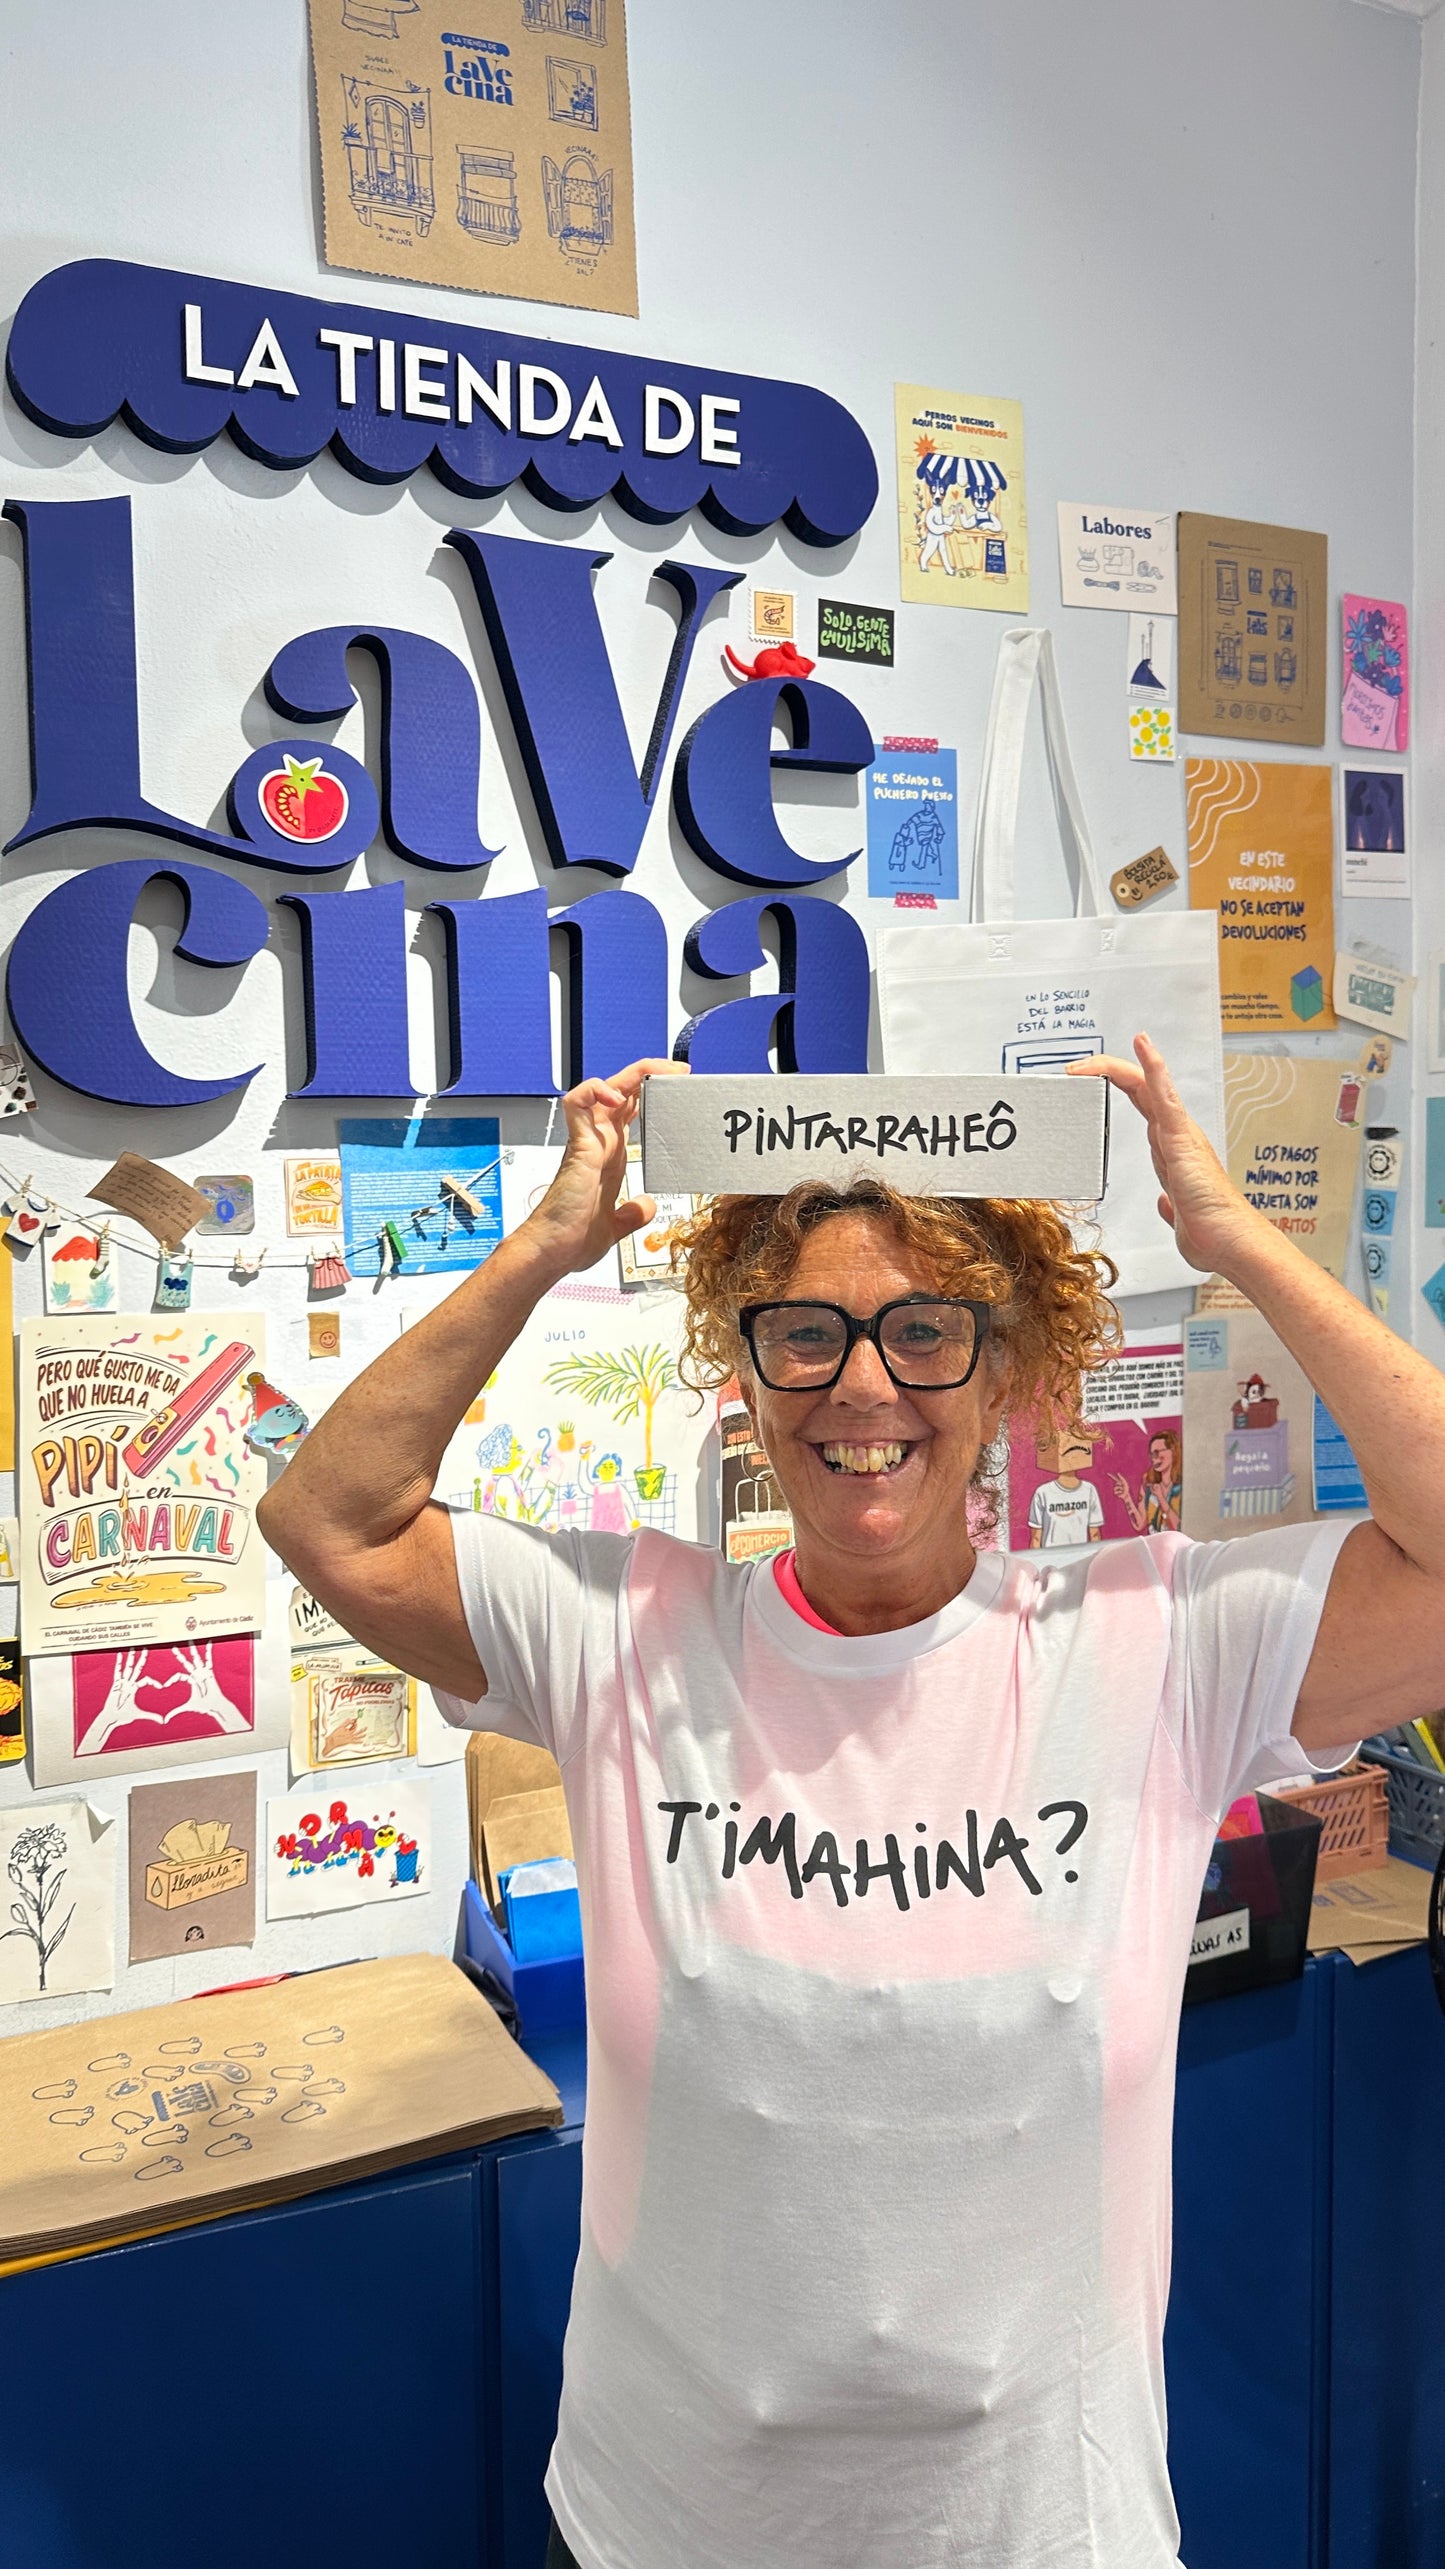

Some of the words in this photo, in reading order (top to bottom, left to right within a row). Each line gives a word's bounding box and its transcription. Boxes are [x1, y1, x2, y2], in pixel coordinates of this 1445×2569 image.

[184, 305, 299, 396] LA
[320, 328, 623, 448] TIENDA
[645, 384, 742, 467] DE
[925, 410, 957, 423] PERROS
[960, 415, 995, 428] VECINOS
[912, 417, 933, 429] AQUÍ
[935, 421, 953, 431] SON
[955, 424, 1008, 440] BIENVENIDOS
[1082, 515, 1152, 539] Labores
[823, 608, 852, 631] SOLO
[856, 615, 890, 638] GENTE
[872, 773, 888, 784] HE
[892, 773, 929, 787] DEJADO
[931, 776, 944, 787] EL
[874, 787, 919, 800] PUCHERO
[921, 790, 953, 801] PUESTO
[1123, 856, 1156, 880] BOLSITA
[1240, 850, 1256, 868] EN
[1257, 850, 1286, 869] ESTE
[1228, 875, 1295, 893] VECINDARIO
[1220, 899, 1237, 916] NO
[1240, 899, 1254, 917] SE
[1256, 901, 1305, 917] ACEPTAN
[1221, 924, 1307, 942] DEVOLUCIONES
[1025, 993, 1037, 1002] EN
[1039, 992, 1049, 1002] LO
[1053, 989, 1090, 1001] SENCILLO
[1029, 1007, 1048, 1017] DEL
[1054, 1003, 1086, 1015] BARRIO
[1017, 1018, 1046, 1033] ESTÁ
[1052, 1019, 1062, 1029] LA
[1068, 1018, 1095, 1030] MAGIA
[1255, 1145, 1279, 1163] LOS
[1280, 1146, 1319, 1164] PAGOS
[294, 1170, 306, 1182] LA
[1246, 1165, 1292, 1185] MÍNIMO
[1295, 1170, 1319, 1188] POR
[1243, 1192, 1292, 1210] TARJETA
[1294, 1193, 1318, 1211] SON
[293, 1206, 339, 1226] TORTILLA
[1269, 1217, 1317, 1234] URITOS
[544, 1329, 586, 1342] JULIO
[37, 1360, 72, 1391] PERO
[76, 1350, 106, 1379] QUÉ
[104, 1358, 143, 1383] GUSTO
[144, 1366, 164, 1389] ME
[162, 1374, 181, 1396] DA
[39, 1388, 64, 1422] QUE
[68, 1384, 87, 1412] NO
[91, 1384, 135, 1407] HUELA
[136, 1391, 149, 1410] A
[31, 1424, 130, 1508] PIPÍ
[1235, 1451, 1268, 1464] Regala
[146, 1486, 174, 1500] en
[1049, 1501, 1087, 1513] amazon
[46, 1503, 234, 1568] CARNAVAL
[740, 1533, 787, 1555] COMERCIO
[52, 1628, 81, 1638] CARNAVAL
[110, 1631, 130, 1639] CALLES
[329, 1681, 394, 1711] Tapitas
[171, 1864, 230, 1892] Lloradita
